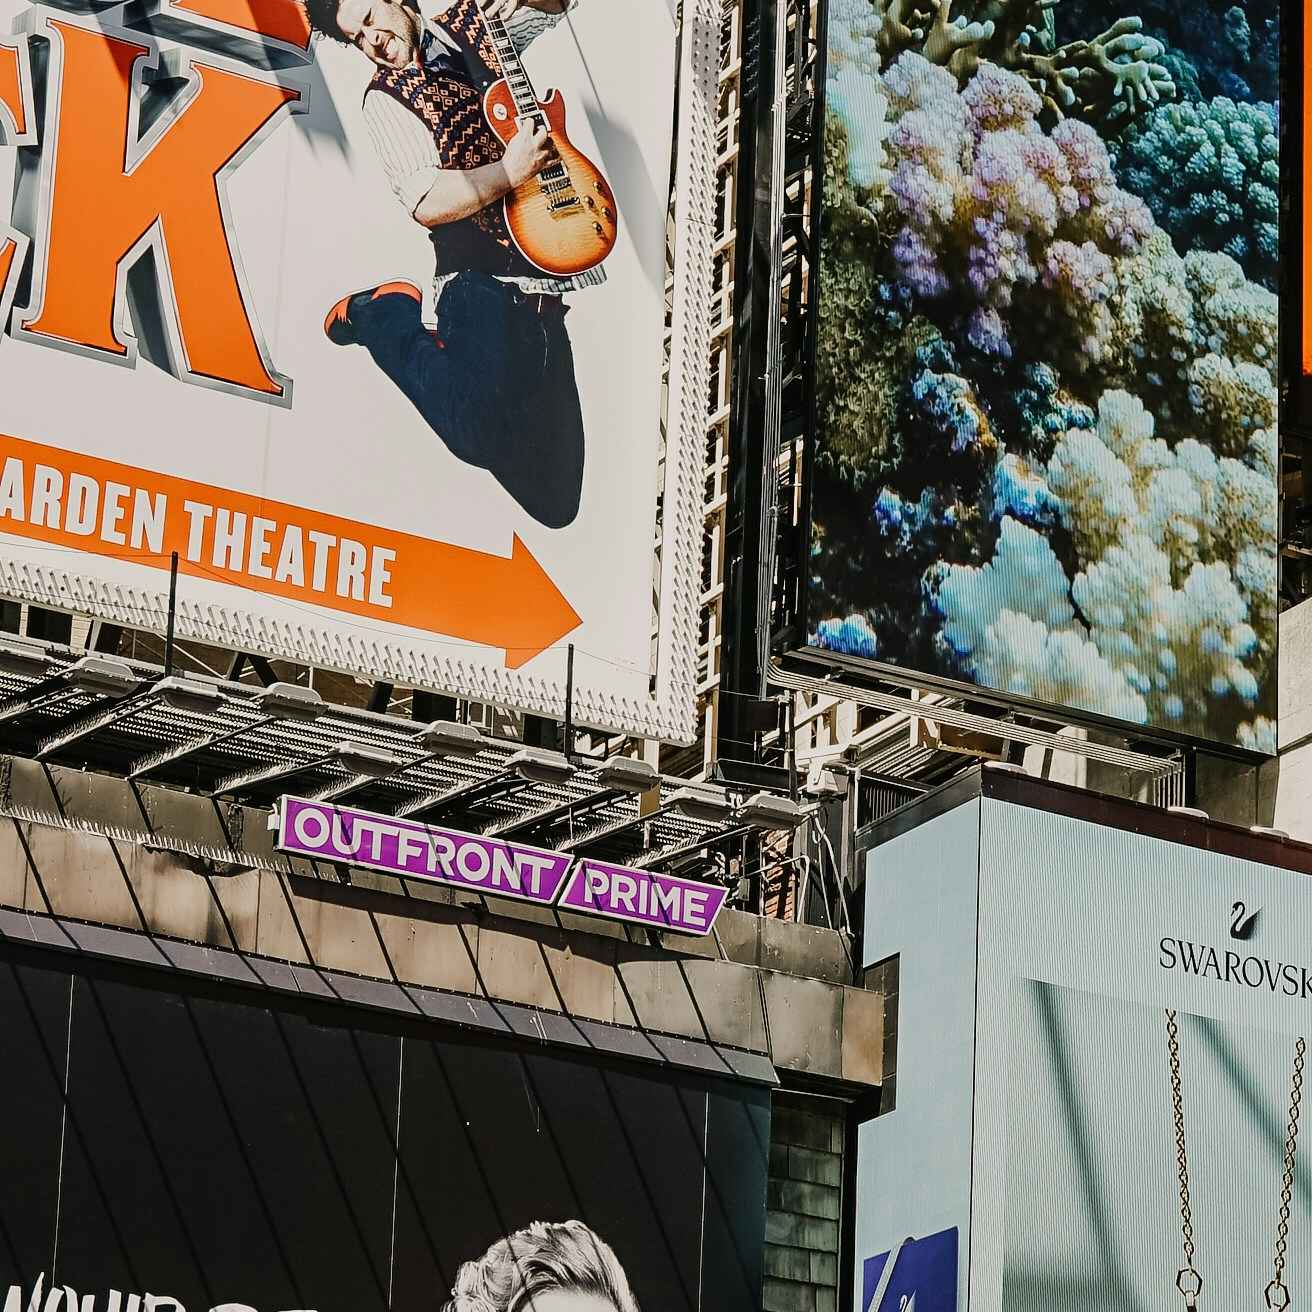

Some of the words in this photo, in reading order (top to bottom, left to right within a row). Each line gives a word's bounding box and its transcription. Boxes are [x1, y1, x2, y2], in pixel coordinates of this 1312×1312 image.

[0, 10, 308, 406] K
[0, 456, 168, 556] ARDEN
[183, 499, 398, 609] THEATRE
[294, 808, 557, 895] OUTFRONT
[583, 869, 709, 927] PRIME
